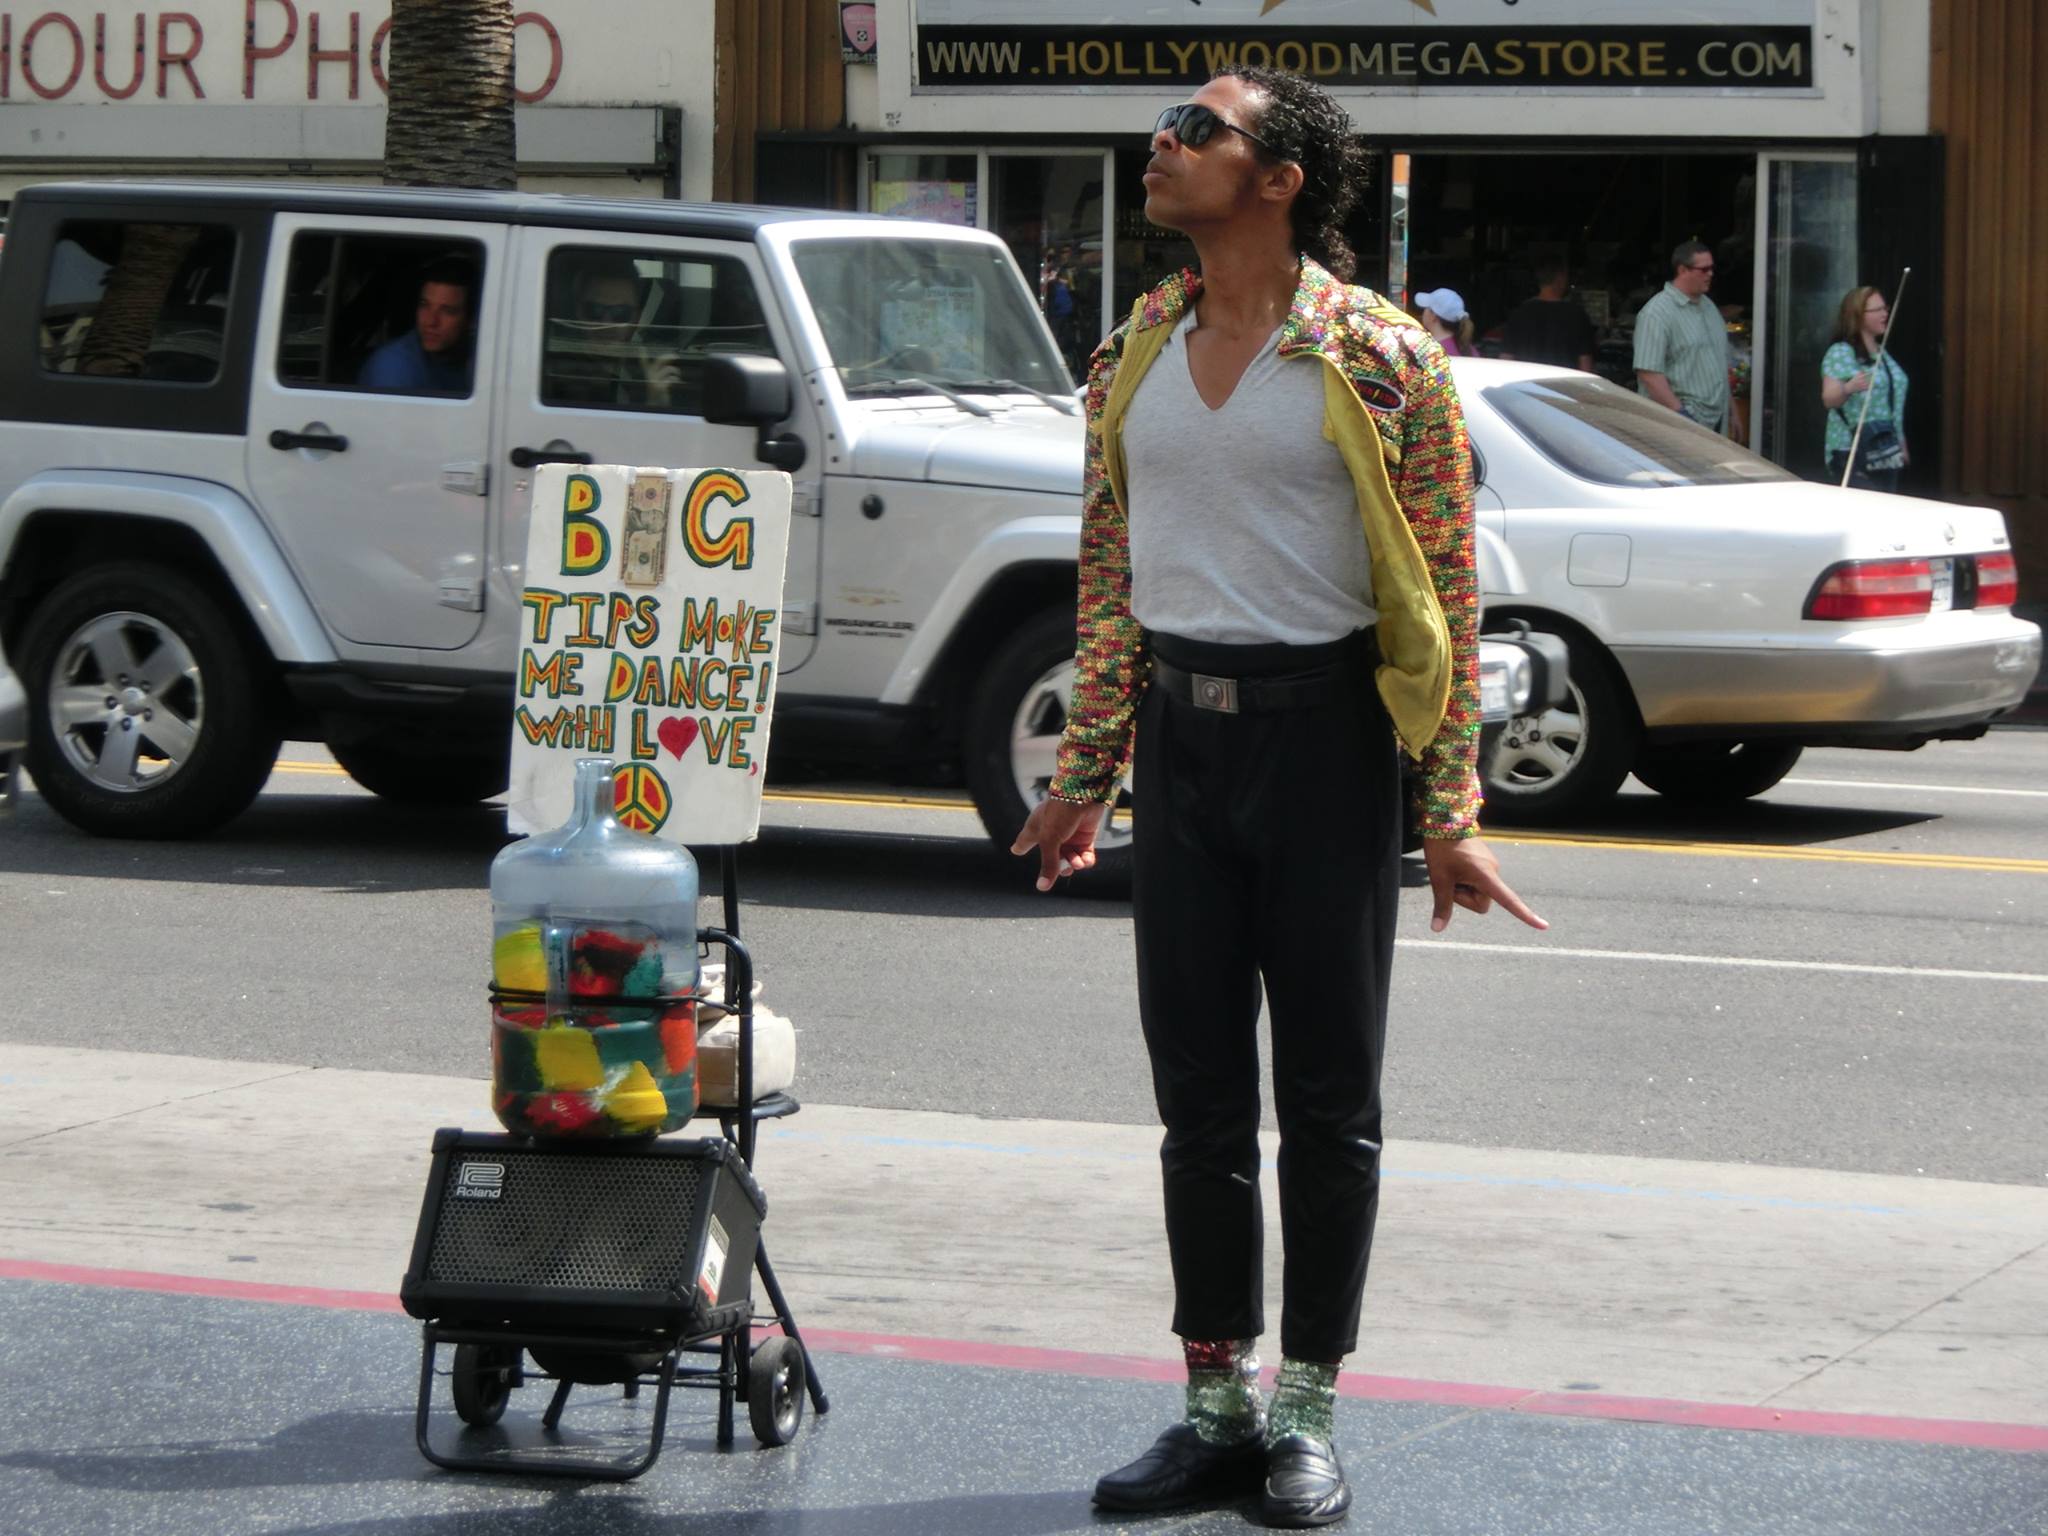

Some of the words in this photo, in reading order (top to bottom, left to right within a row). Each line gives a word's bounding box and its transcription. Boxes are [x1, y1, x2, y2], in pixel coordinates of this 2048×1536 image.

[244, 0, 563, 102] PHO
[927, 40, 1802, 76] WWW.HOLLYWOODMEGASTORE.COM
[560, 469, 754, 577] BG
[523, 588, 661, 649] TIPS
[520, 648, 584, 699] ME
[604, 652, 772, 713] DANCE!
[632, 708, 759, 776] LVE,
[456, 1186, 501, 1198] Roland
